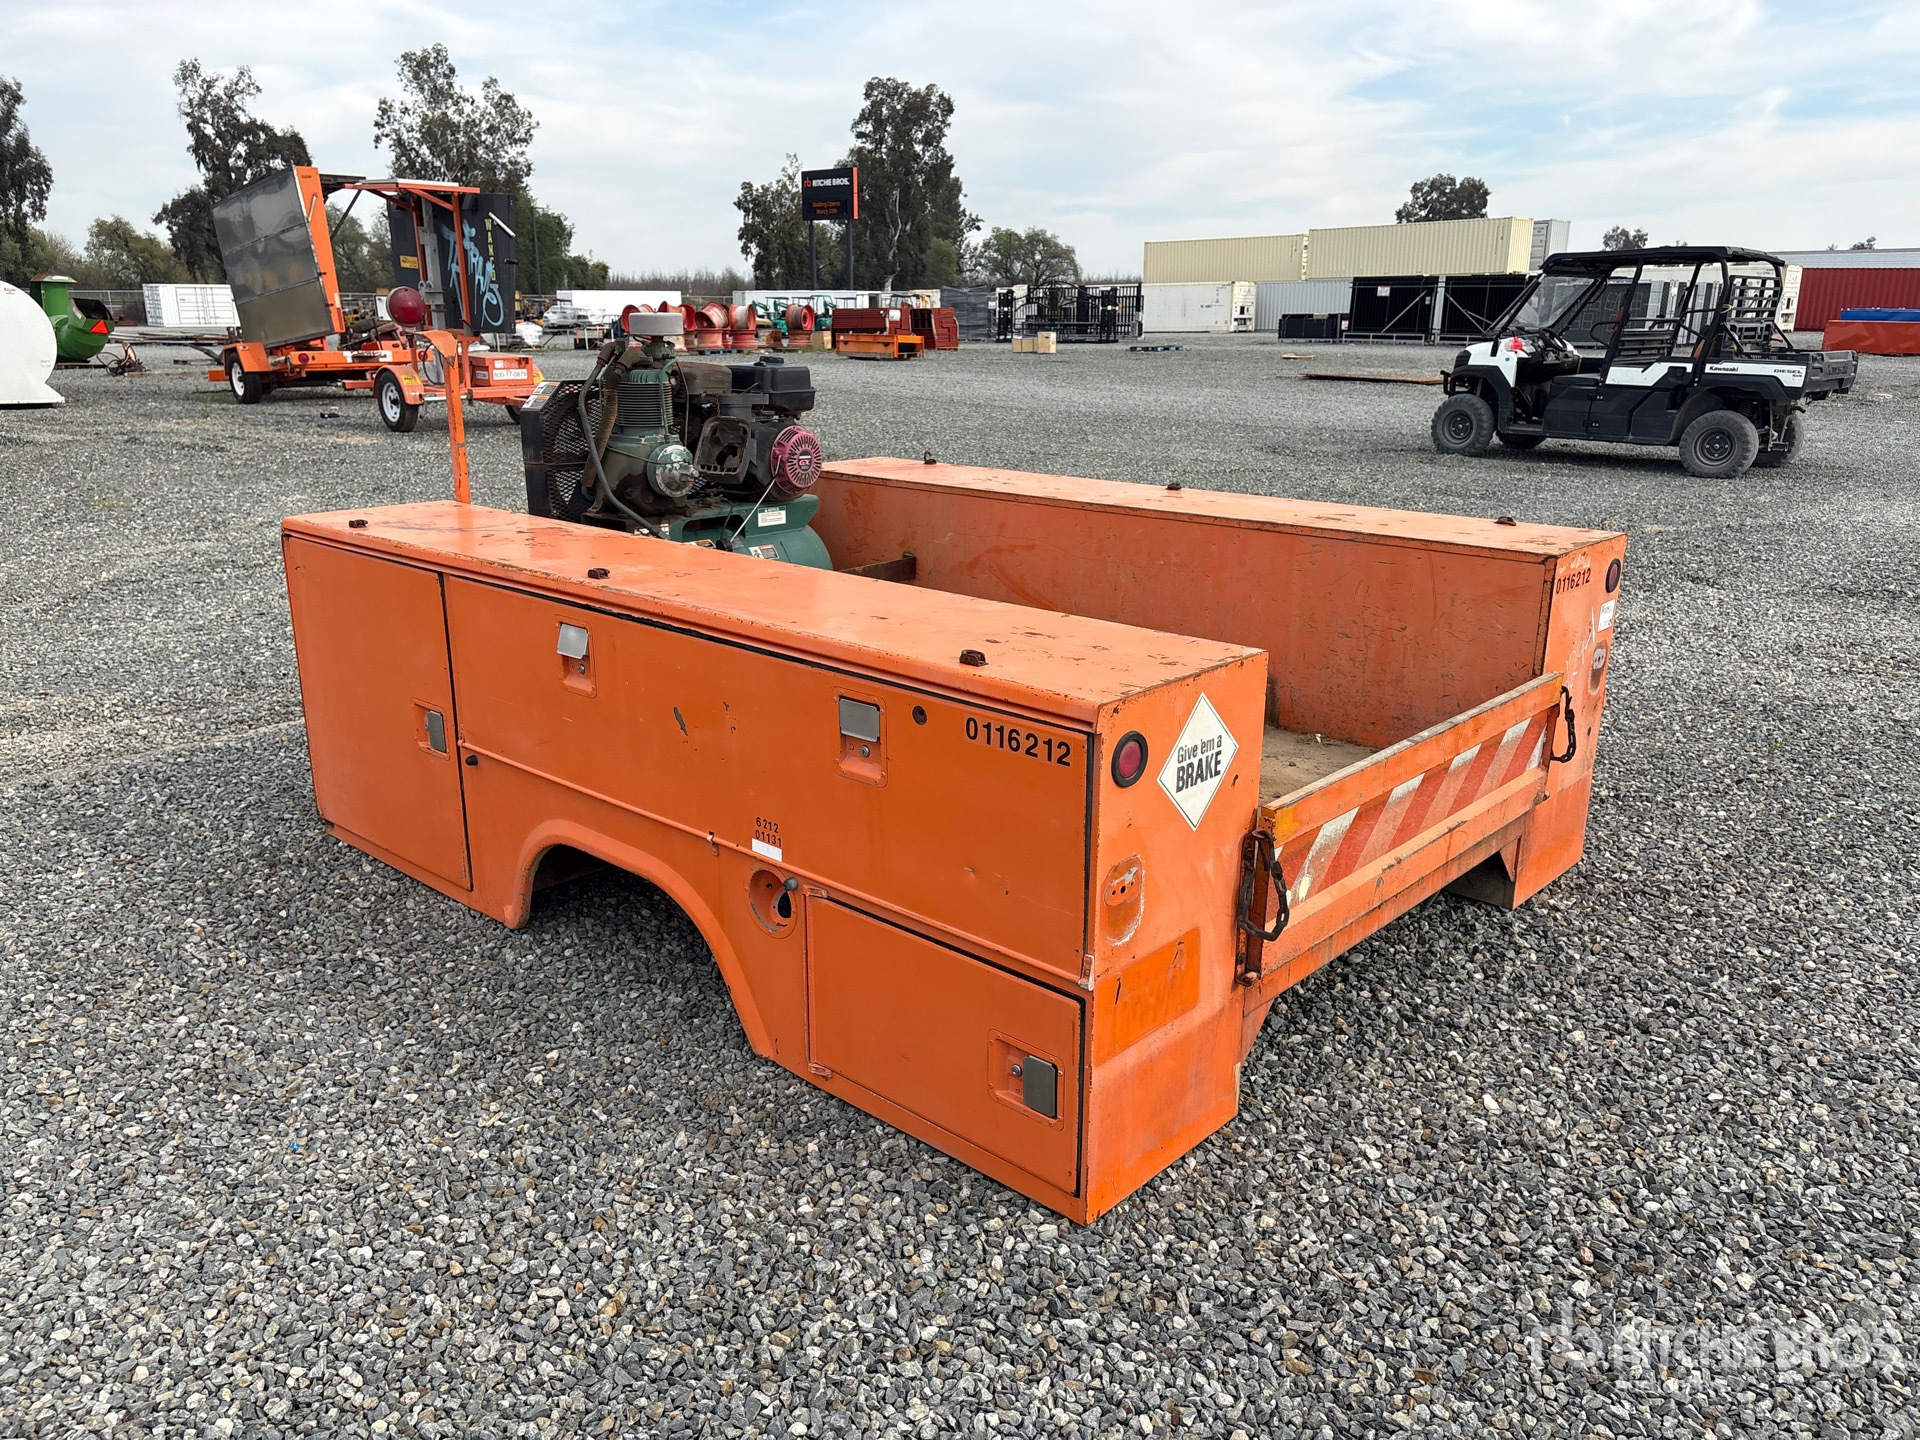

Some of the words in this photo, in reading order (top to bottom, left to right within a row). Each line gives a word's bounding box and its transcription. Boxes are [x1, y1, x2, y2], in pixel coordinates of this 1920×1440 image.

[812, 179, 832, 187] RITCHIE
[1555, 567, 1592, 595] 0116212
[965, 716, 1071, 768] 0116212
[1177, 744, 1199, 764] Give
[1216, 734, 1222, 749] a
[1175, 750, 1222, 794] BRAKE
[755, 816, 779, 834] 6212
[755, 829, 782, 848] 01131
